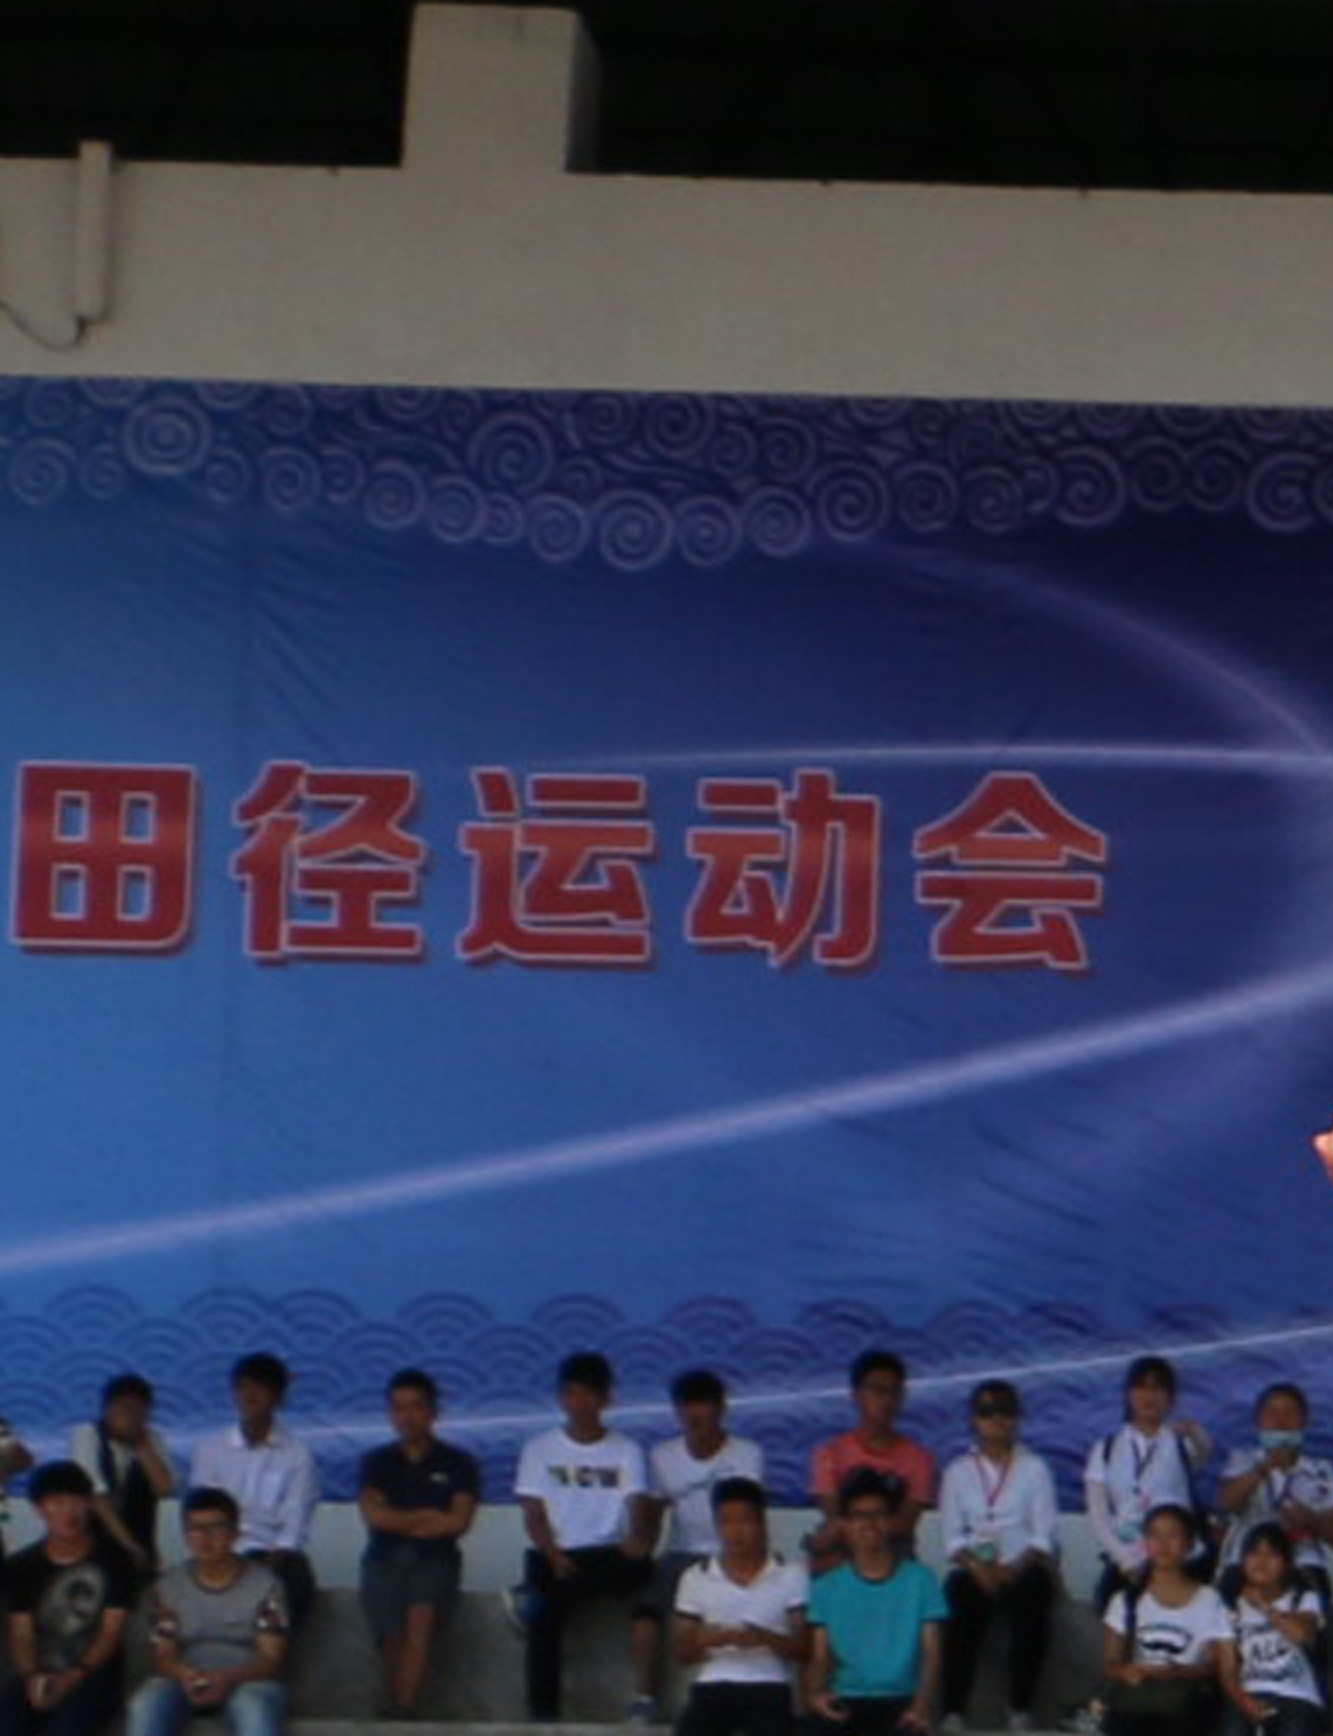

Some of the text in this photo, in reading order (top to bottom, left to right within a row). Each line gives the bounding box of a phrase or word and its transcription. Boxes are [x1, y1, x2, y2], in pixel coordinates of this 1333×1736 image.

[11, 758, 1109, 969] 田径运动会
